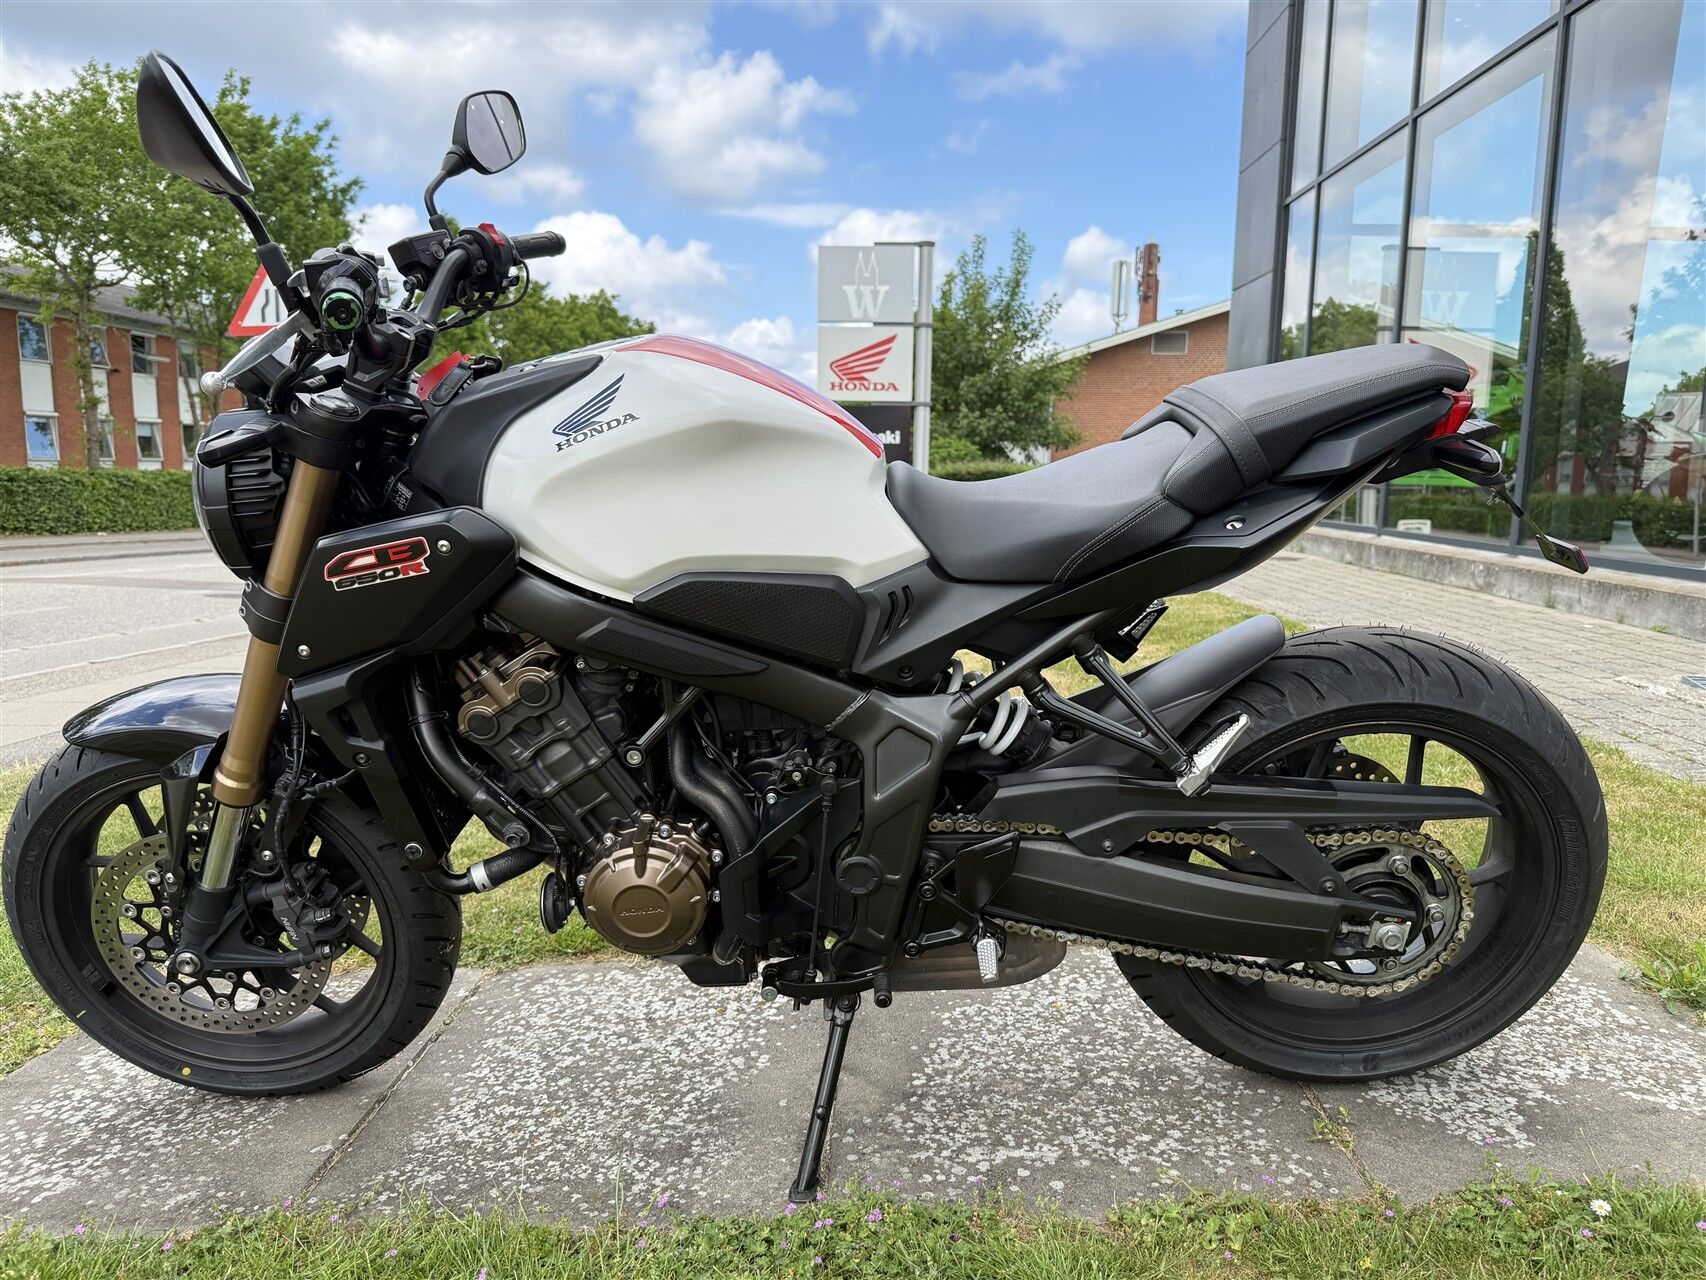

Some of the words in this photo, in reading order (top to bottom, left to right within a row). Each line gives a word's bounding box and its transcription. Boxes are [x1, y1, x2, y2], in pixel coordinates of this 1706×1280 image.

[841, 285, 890, 319] W
[829, 381, 900, 393] HONDA
[555, 412, 640, 453] HONDA
[325, 537, 430, 581] CB
[334, 561, 430, 591] 650R
[619, 906, 665, 917] HONDA
